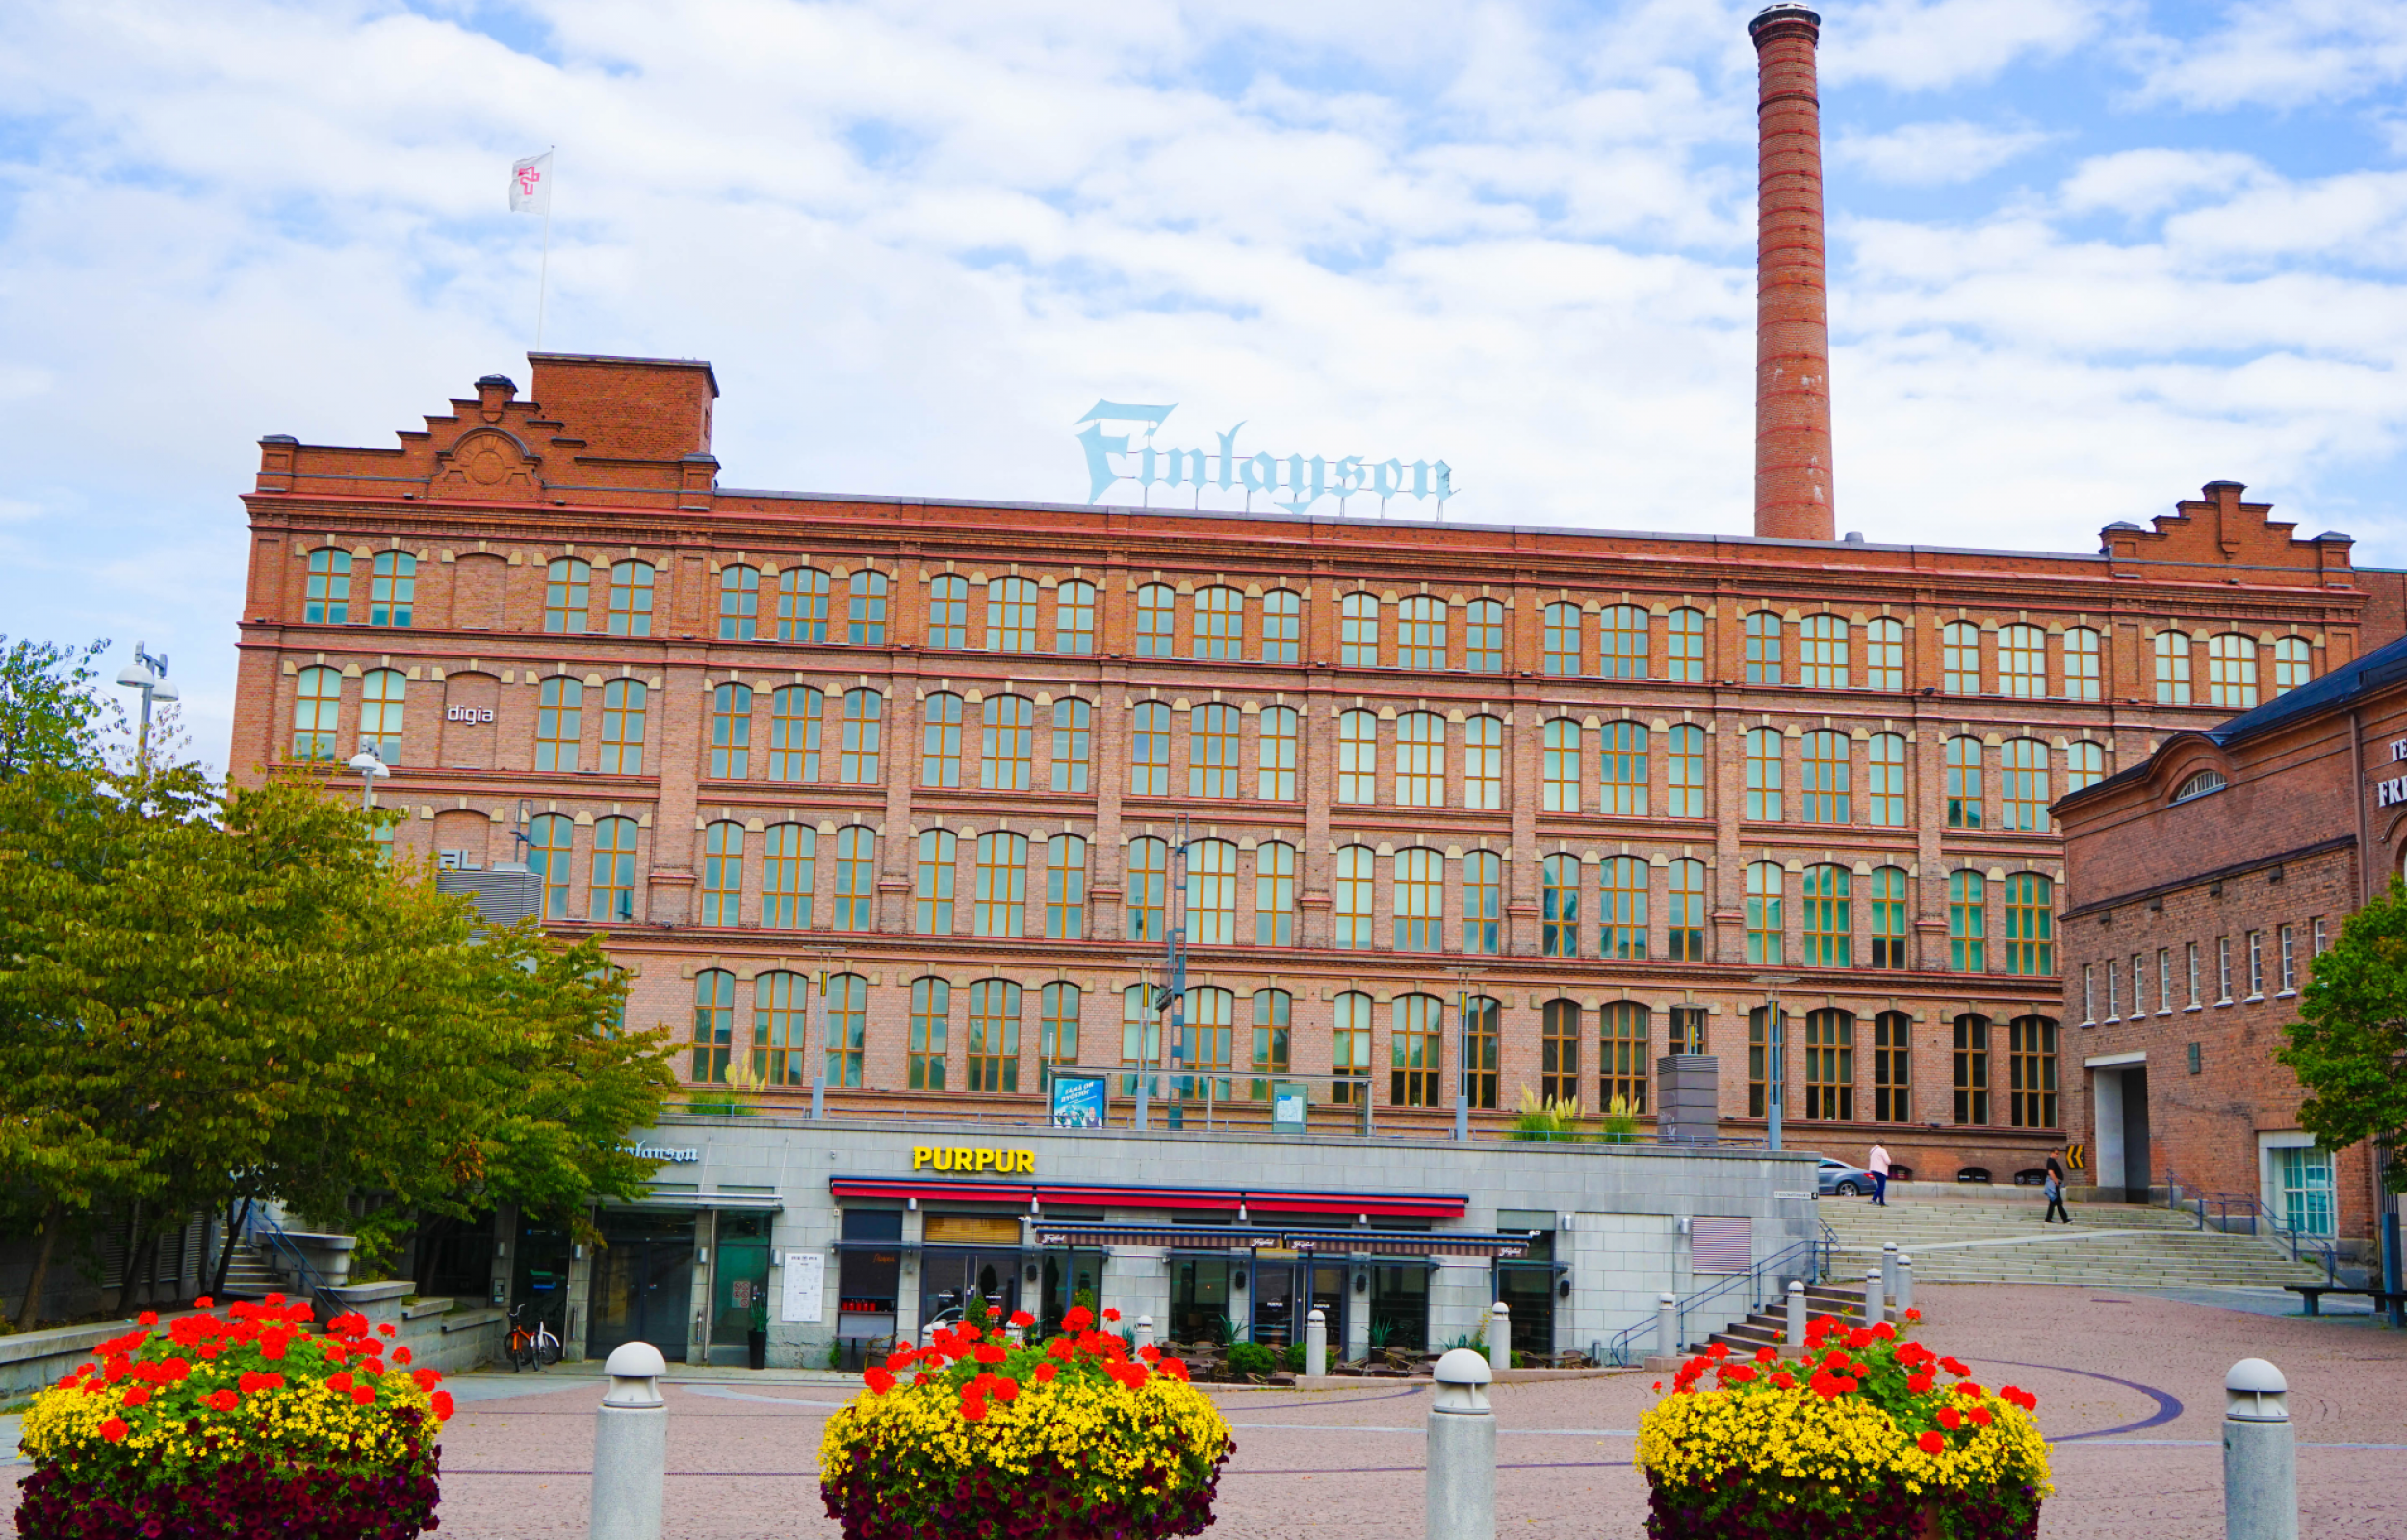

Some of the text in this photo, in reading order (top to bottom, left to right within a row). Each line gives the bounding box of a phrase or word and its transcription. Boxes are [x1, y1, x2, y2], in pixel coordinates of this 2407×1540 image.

[1073, 398, 1461, 514] Finlayson
[447, 705, 493, 726] digia
[913, 1146, 1035, 1173] PURPUR
